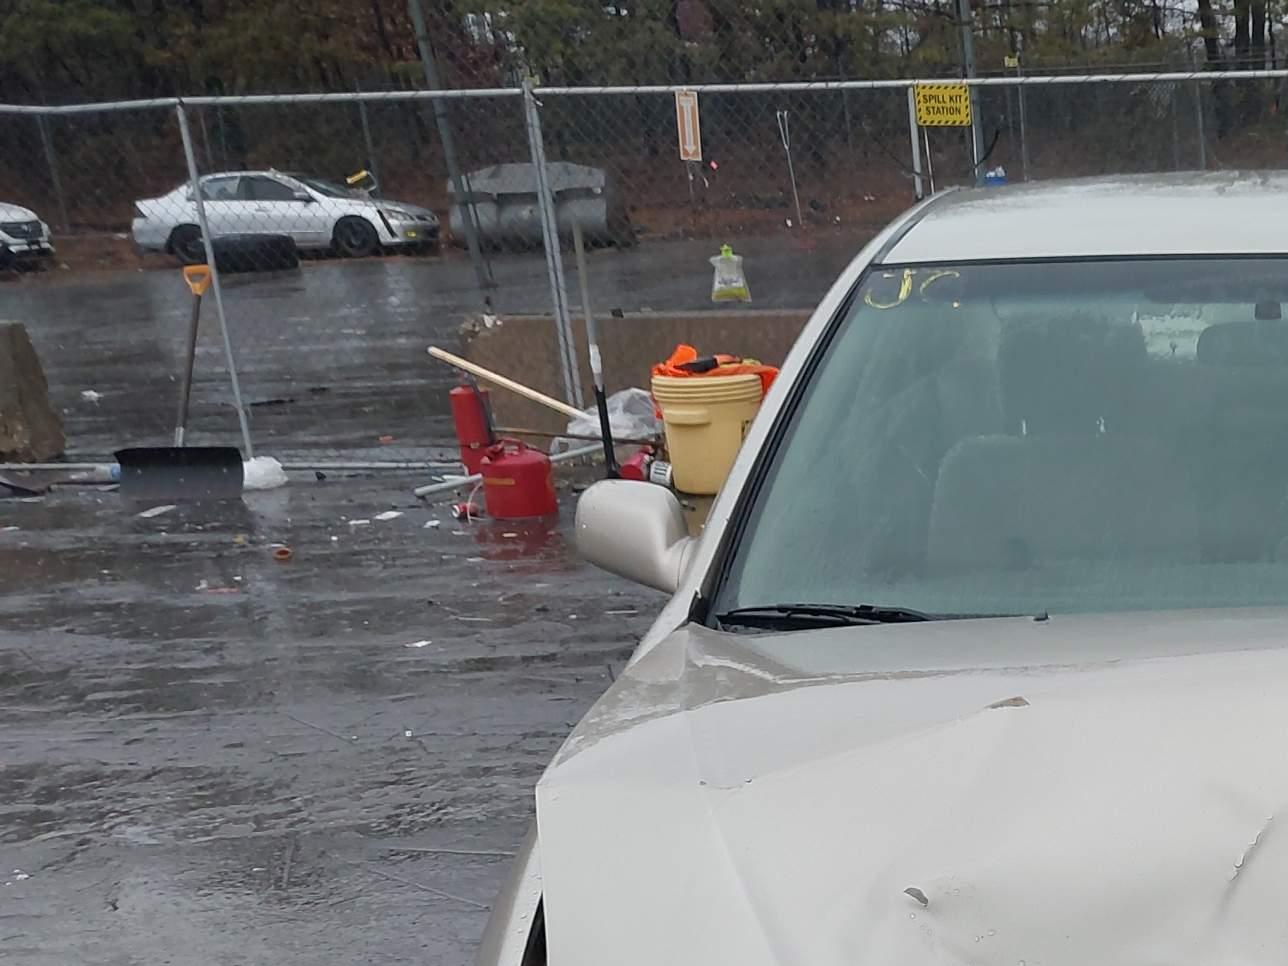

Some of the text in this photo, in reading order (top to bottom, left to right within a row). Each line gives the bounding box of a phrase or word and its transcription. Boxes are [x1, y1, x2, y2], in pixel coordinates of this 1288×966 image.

[922, 94, 962, 104] SPILL KIT
[925, 105, 961, 116] STATION
